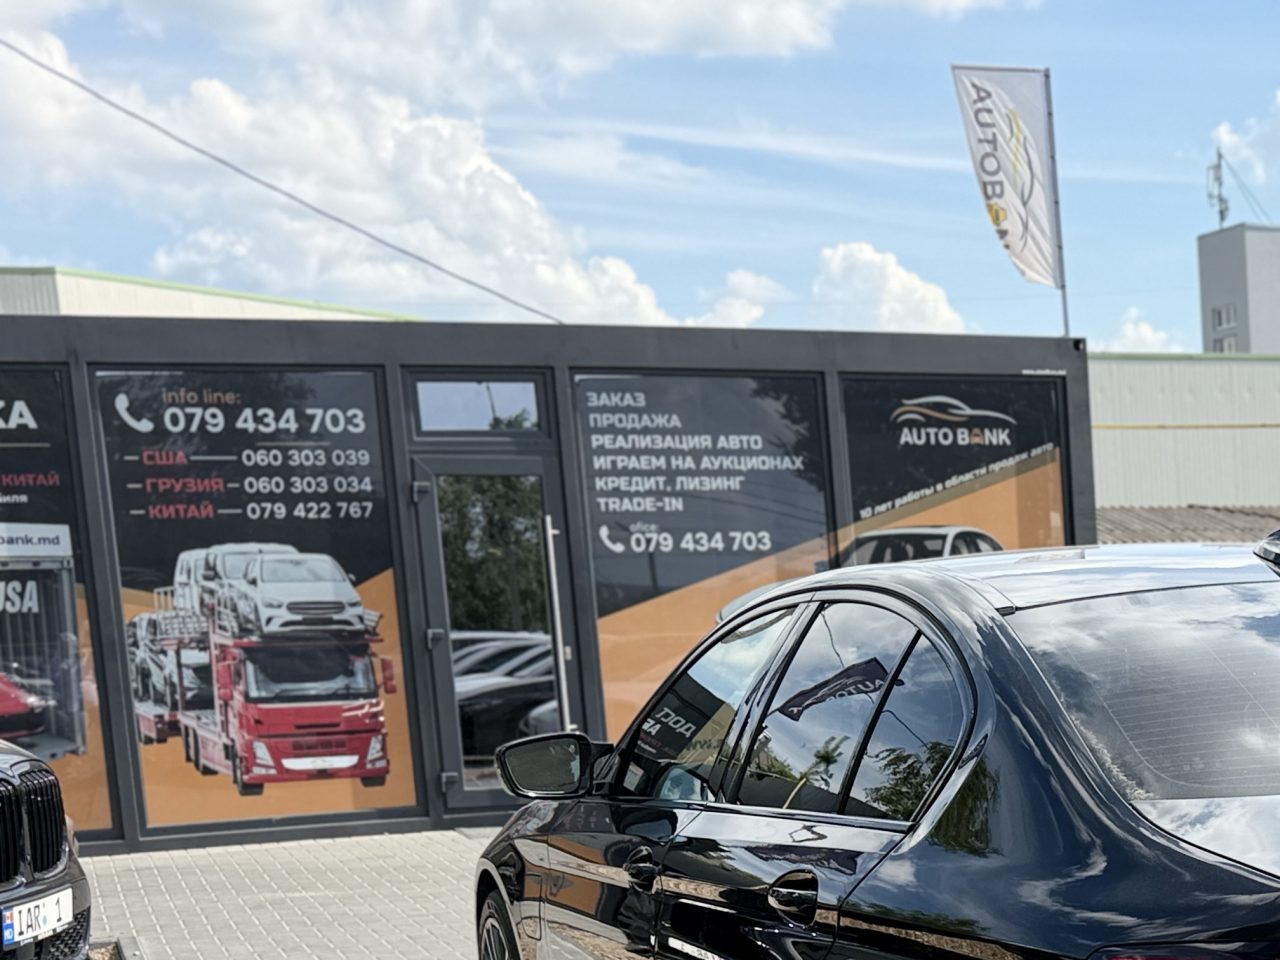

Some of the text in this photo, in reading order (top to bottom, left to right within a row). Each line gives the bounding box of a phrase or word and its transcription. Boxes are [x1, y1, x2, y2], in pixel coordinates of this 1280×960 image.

[162, 388, 241, 404] info line:
[586, 392, 646, 407] ЗАКАЗ
[163, 407, 366, 433] 079 434 703
[589, 413, 682, 429] ПРОДАЖА
[591, 434, 763, 451] РЕАЛИЗАЦИЯ АВТО
[900, 427, 953, 445] AUTO
[142, 449, 371, 466] США 060 303 039
[593, 455, 804, 472] ИГРАЕМ НА АУКЦИОНАХ
[1, 471, 60, 487] КИТАЙ
[145, 476, 373, 493] ГРУЗИЯ 060 303 034
[675, 476, 745, 491] ЛИЗИНГ
[859, 442, 1054, 520] 10 лет работы в области продаж авто
[148, 501, 373, 519] КИТАЙ 079 422 767
[596, 497, 684, 512] TRADE-IN
[630, 531, 772, 552] 079 434 703
